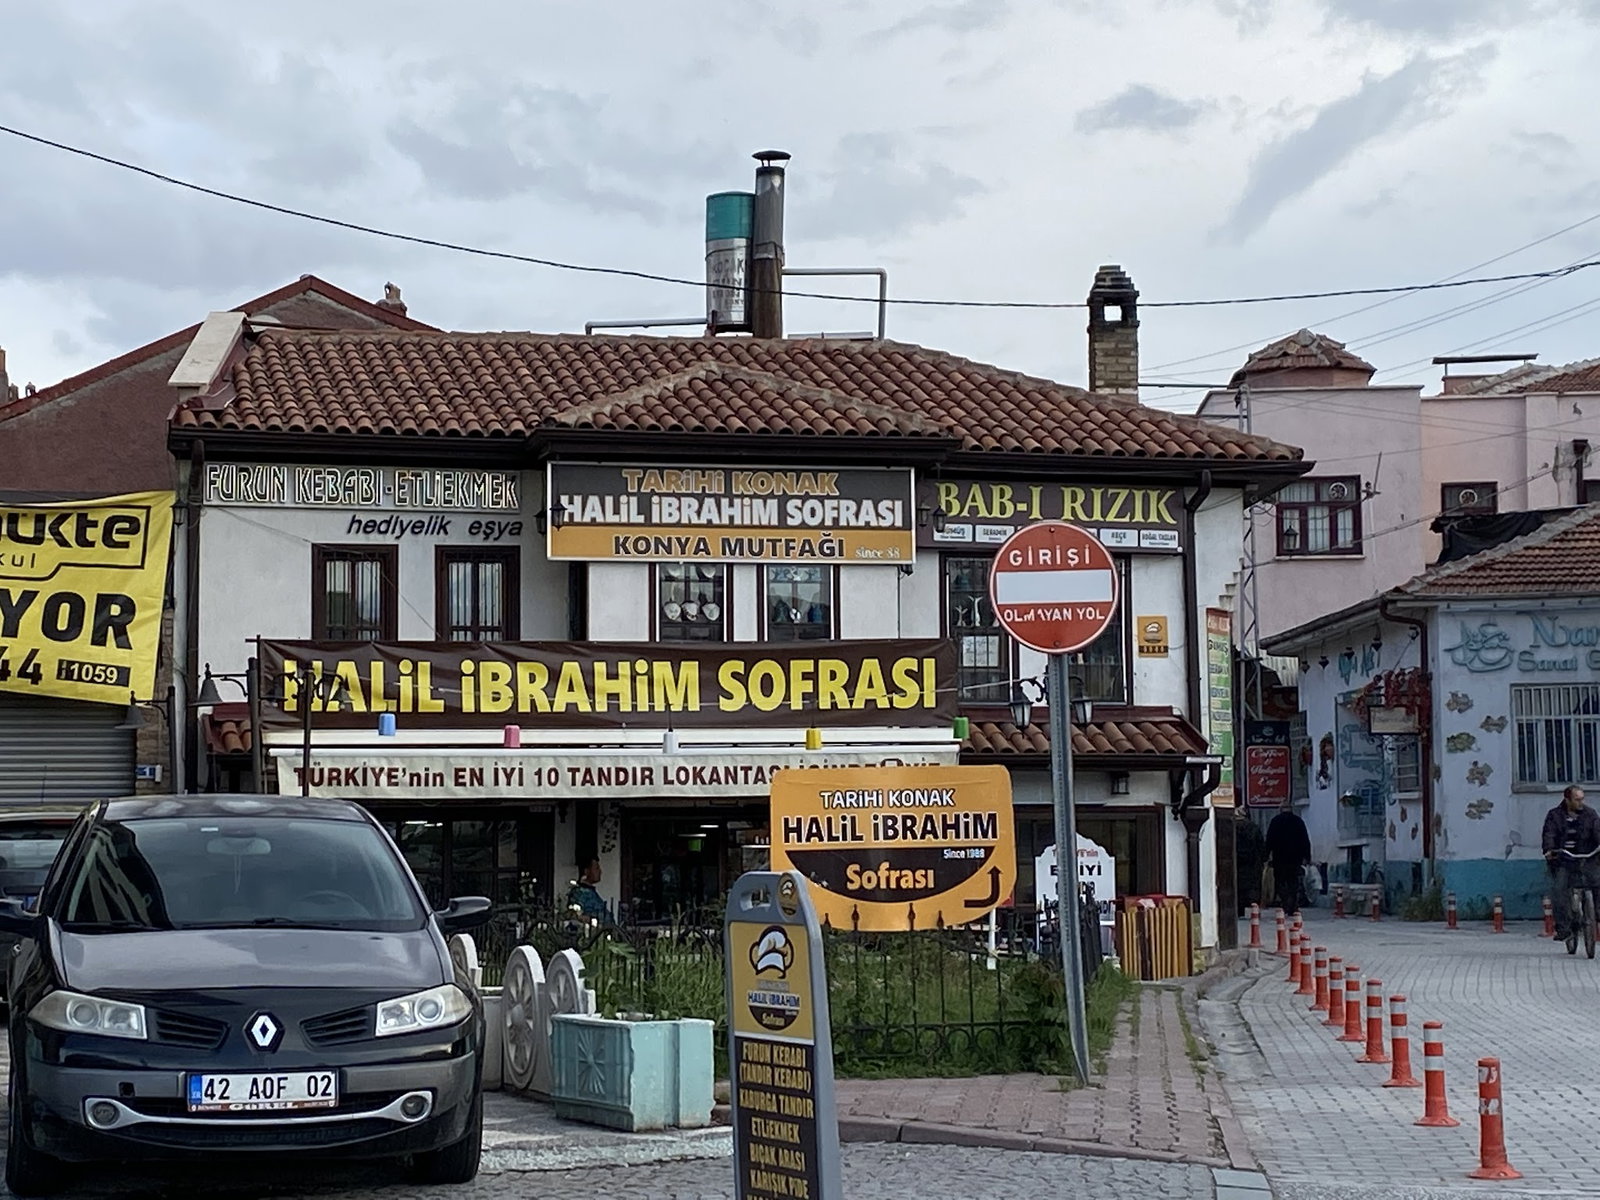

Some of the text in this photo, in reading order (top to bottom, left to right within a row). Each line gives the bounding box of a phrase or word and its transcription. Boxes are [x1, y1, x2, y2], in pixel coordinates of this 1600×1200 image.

[206, 464, 287, 502] FURUN
[733, 471, 839, 496] KONAK
[786, 499, 903, 528] SOFRASI
[937, 482, 1177, 525] BAB-I RIZIK
[0, 512, 141, 549] ükte
[468, 518, 523, 541] eşya
[614, 534, 711, 556] KONYA
[721, 531, 845, 558] MUTFAĞI
[1009, 544, 1091, 567] GİRİŞİ
[1076, 606, 1105, 621] YOL
[70, 662, 118, 684] 1059
[718, 657, 937, 712] SOFRASI
[453, 767, 483, 787] EN
[493, 761, 524, 787] İYİ
[533, 767, 559, 787] 10
[567, 765, 655, 787] TANDIR
[663, 764, 790, 786] LOKANTA
[888, 788, 955, 807] KONAK
[846, 861, 936, 890] Sofrası
[204, 1078, 230, 1100] 42
[307, 1075, 332, 1098] 02
